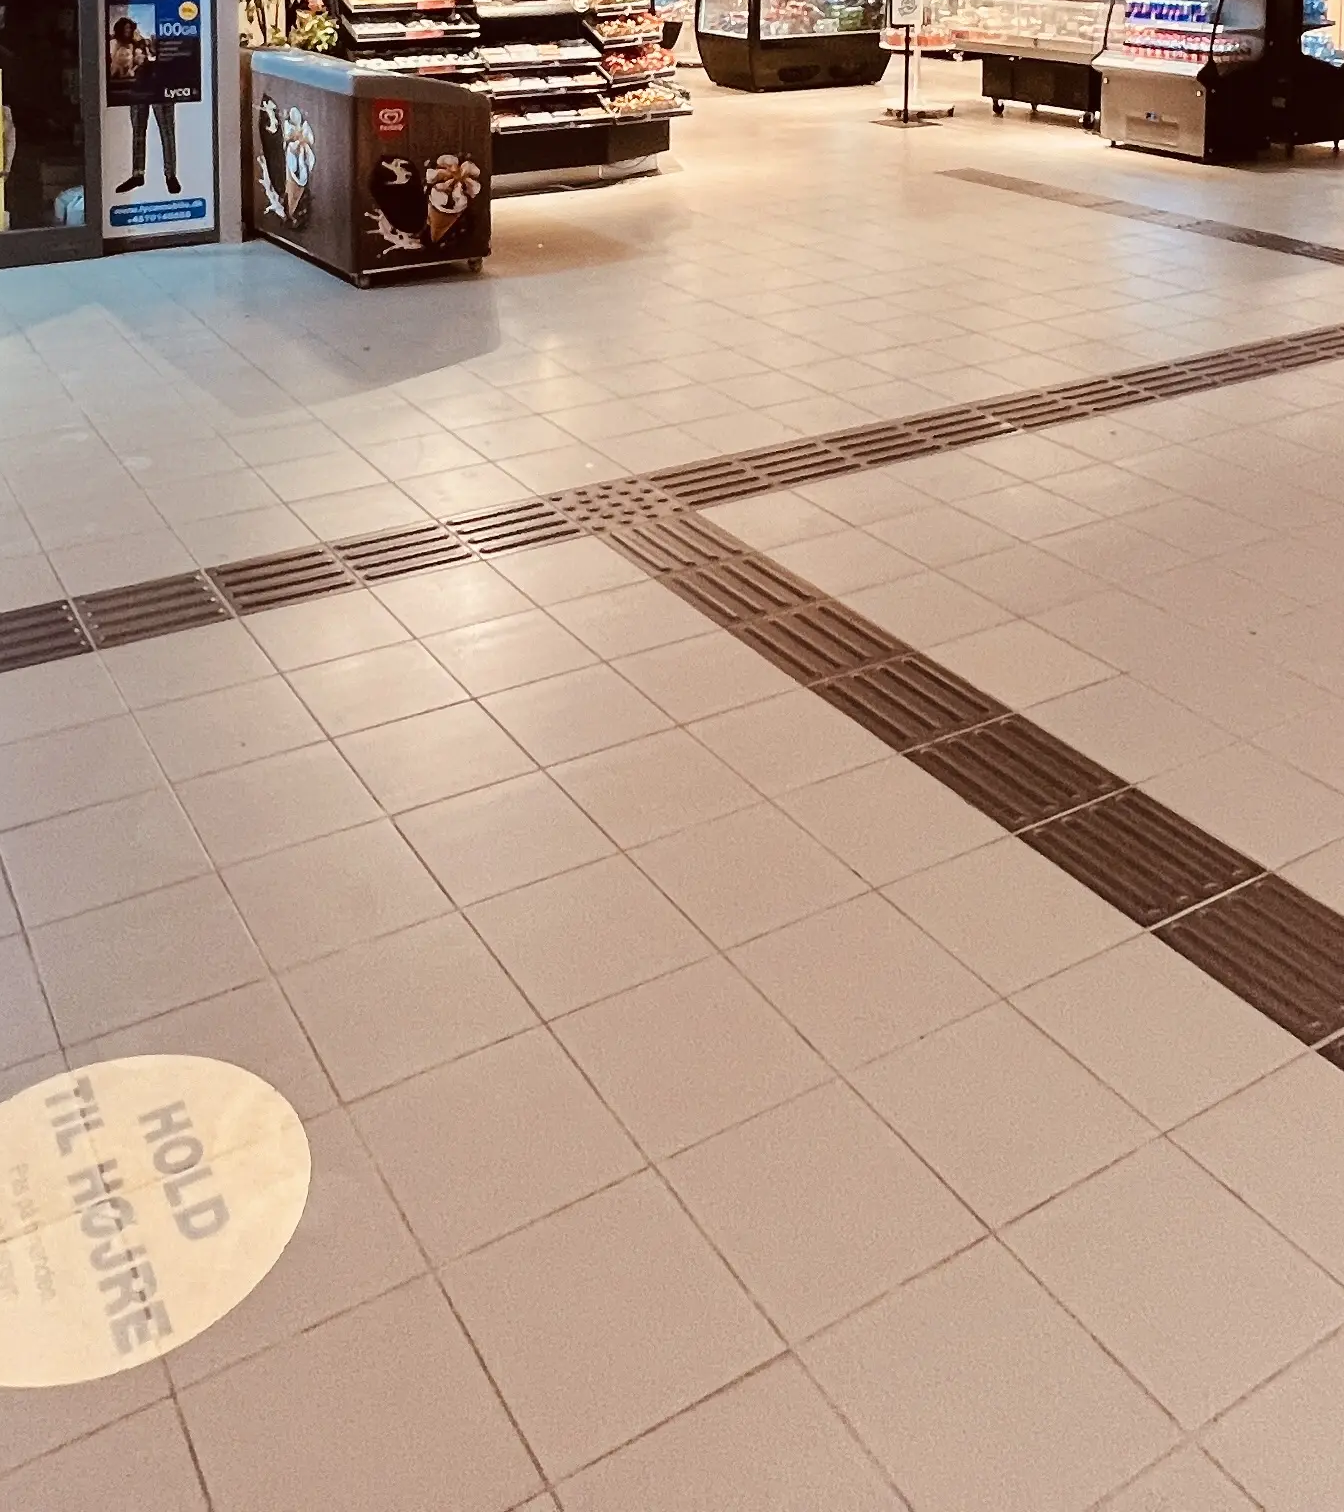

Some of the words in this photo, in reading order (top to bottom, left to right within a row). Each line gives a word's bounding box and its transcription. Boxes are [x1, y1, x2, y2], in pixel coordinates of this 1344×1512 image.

[44, 1076, 105, 1157] TIL
[137, 1100, 231, 1241] HOLD
[67, 1158, 174, 1356] HØJRE
